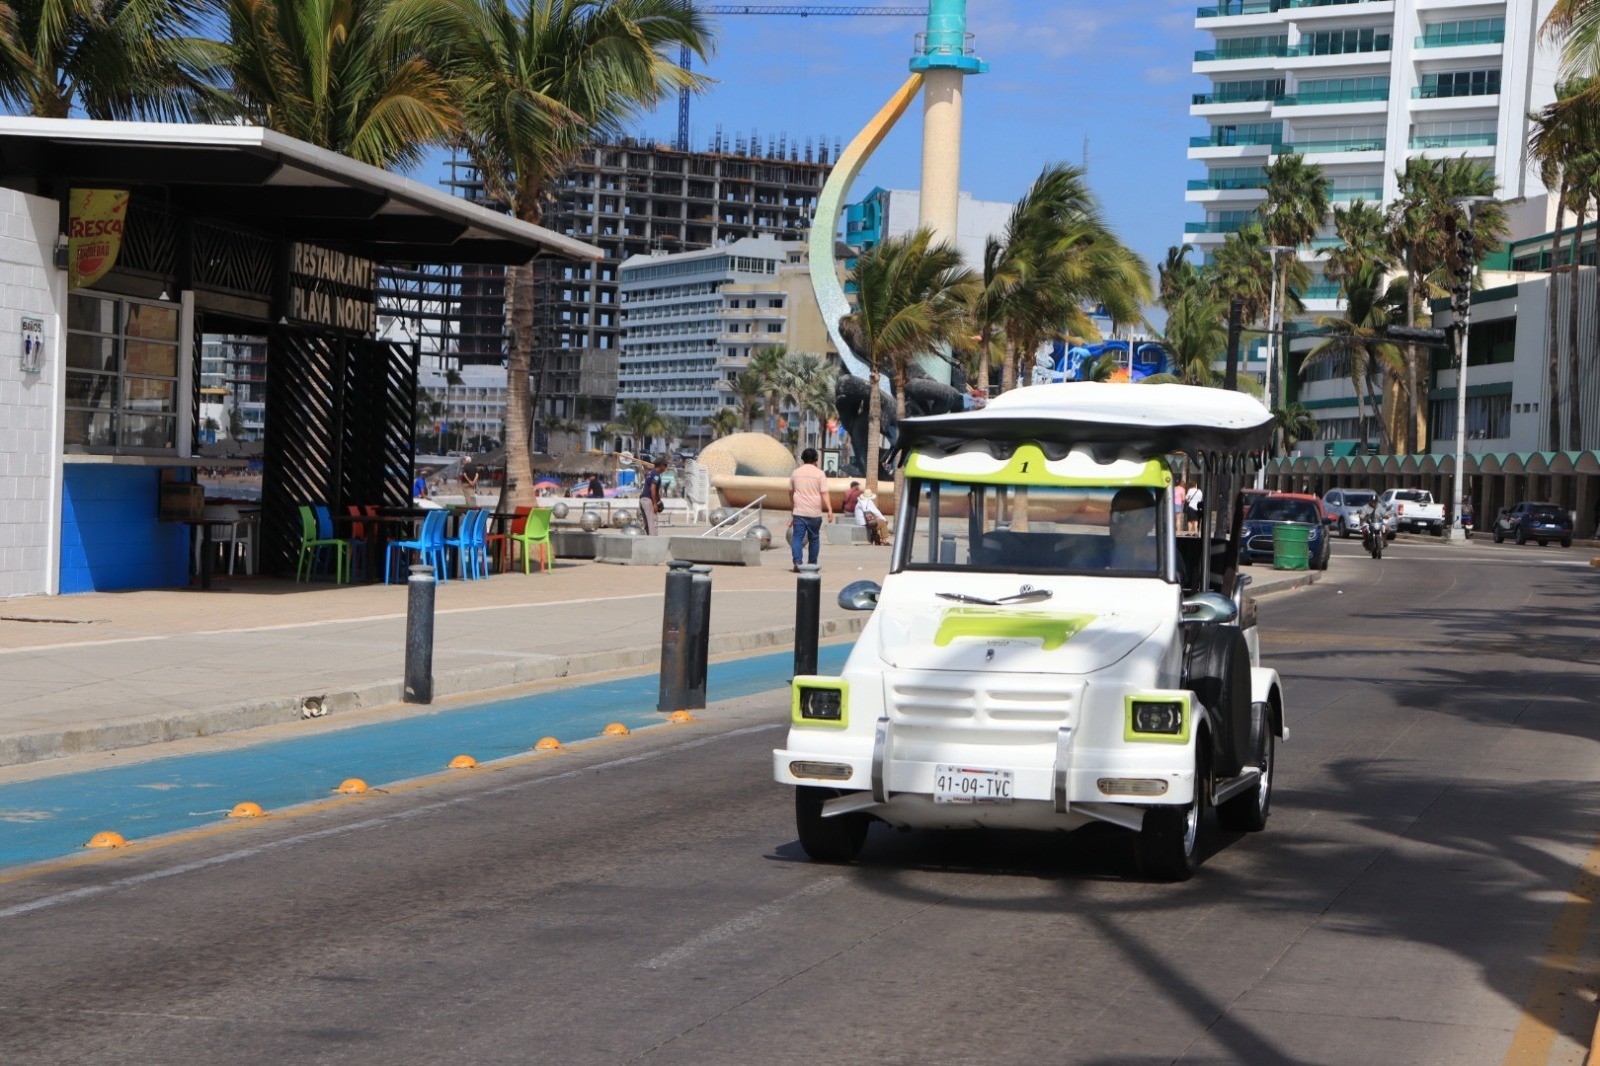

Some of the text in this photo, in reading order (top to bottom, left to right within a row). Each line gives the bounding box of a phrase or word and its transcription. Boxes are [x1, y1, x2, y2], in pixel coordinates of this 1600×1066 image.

[69, 217, 123, 238] FRESCA
[294, 242, 376, 290] RESTAURANTE
[293, 286, 376, 333] PLAYA NORTE
[1019, 461, 1029, 473] 1
[937, 775, 1011, 797] 41-04-TVC
